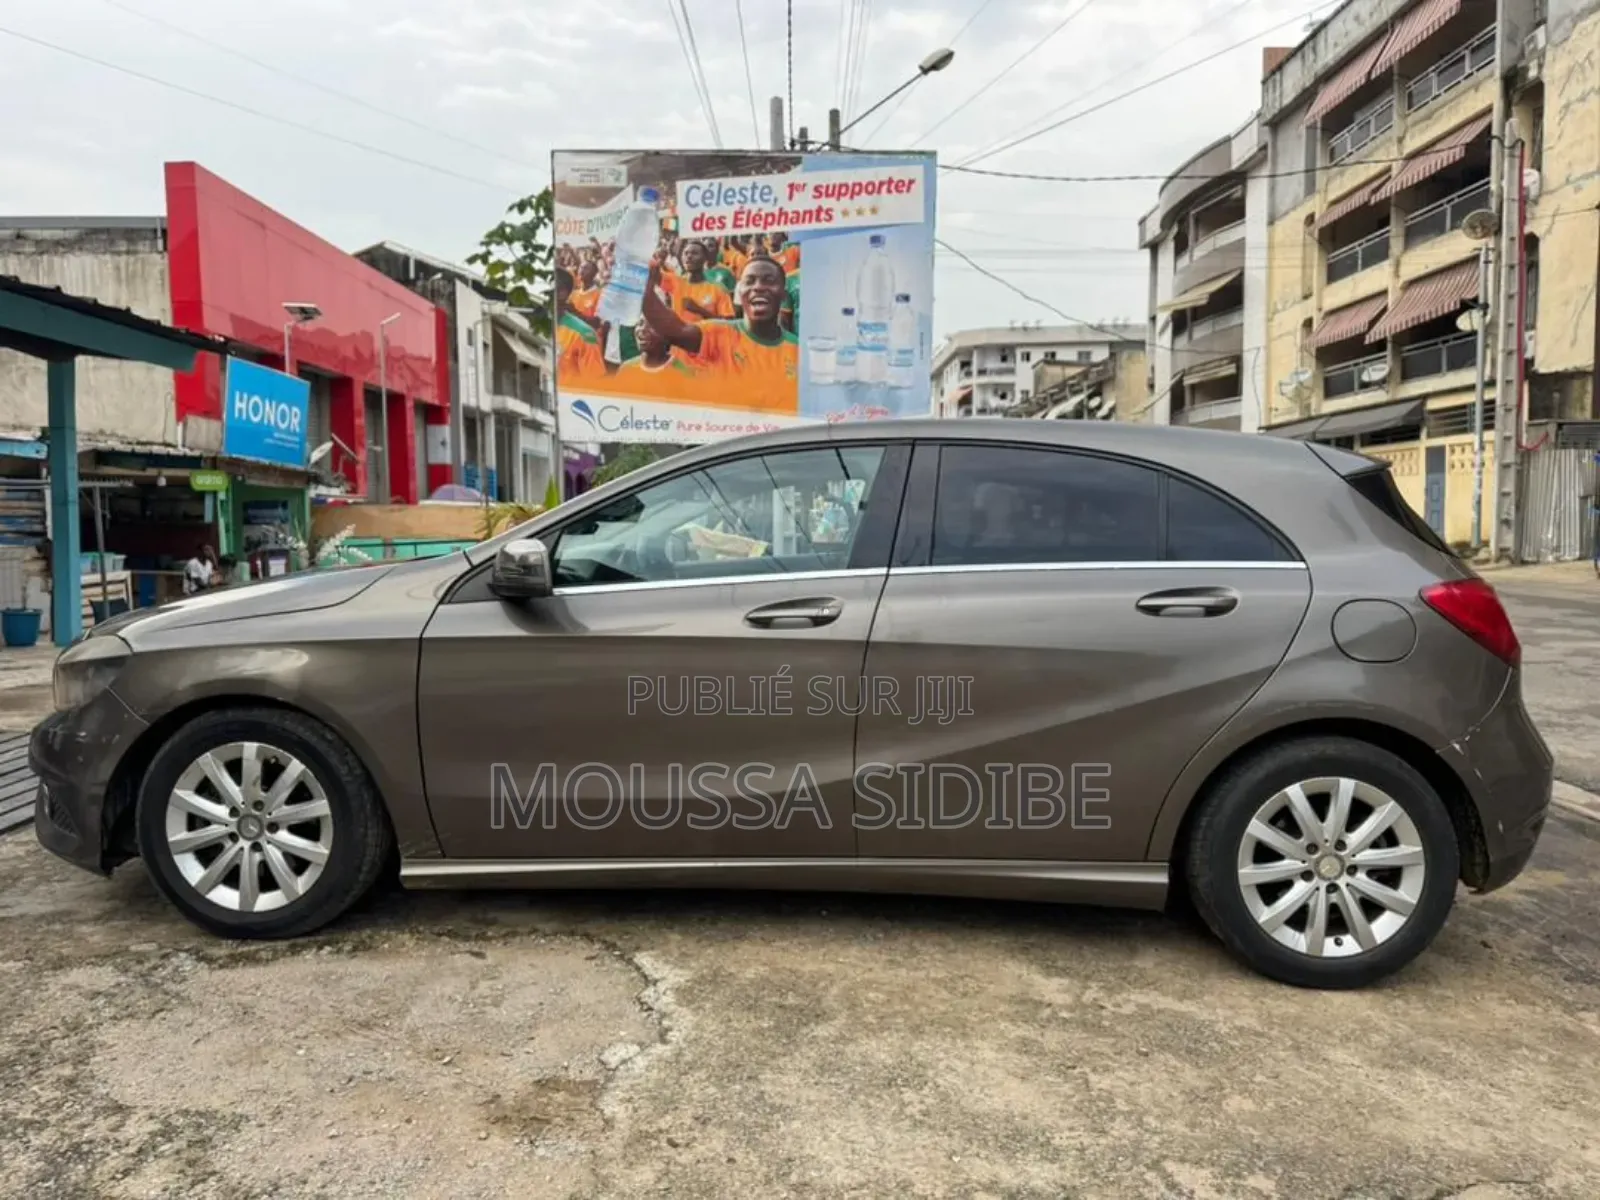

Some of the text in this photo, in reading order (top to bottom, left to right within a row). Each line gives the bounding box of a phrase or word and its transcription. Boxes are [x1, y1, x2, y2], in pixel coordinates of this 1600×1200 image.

[685, 177, 916, 209] Céleste, 1er supporter
[691, 205, 834, 232] des Éléphants
[234, 390, 301, 433] HONOR
[597, 405, 671, 432] Céleste
[676, 421, 701, 432] Pure
[706, 421, 742, 433] Source
[746, 421, 759, 433] de
